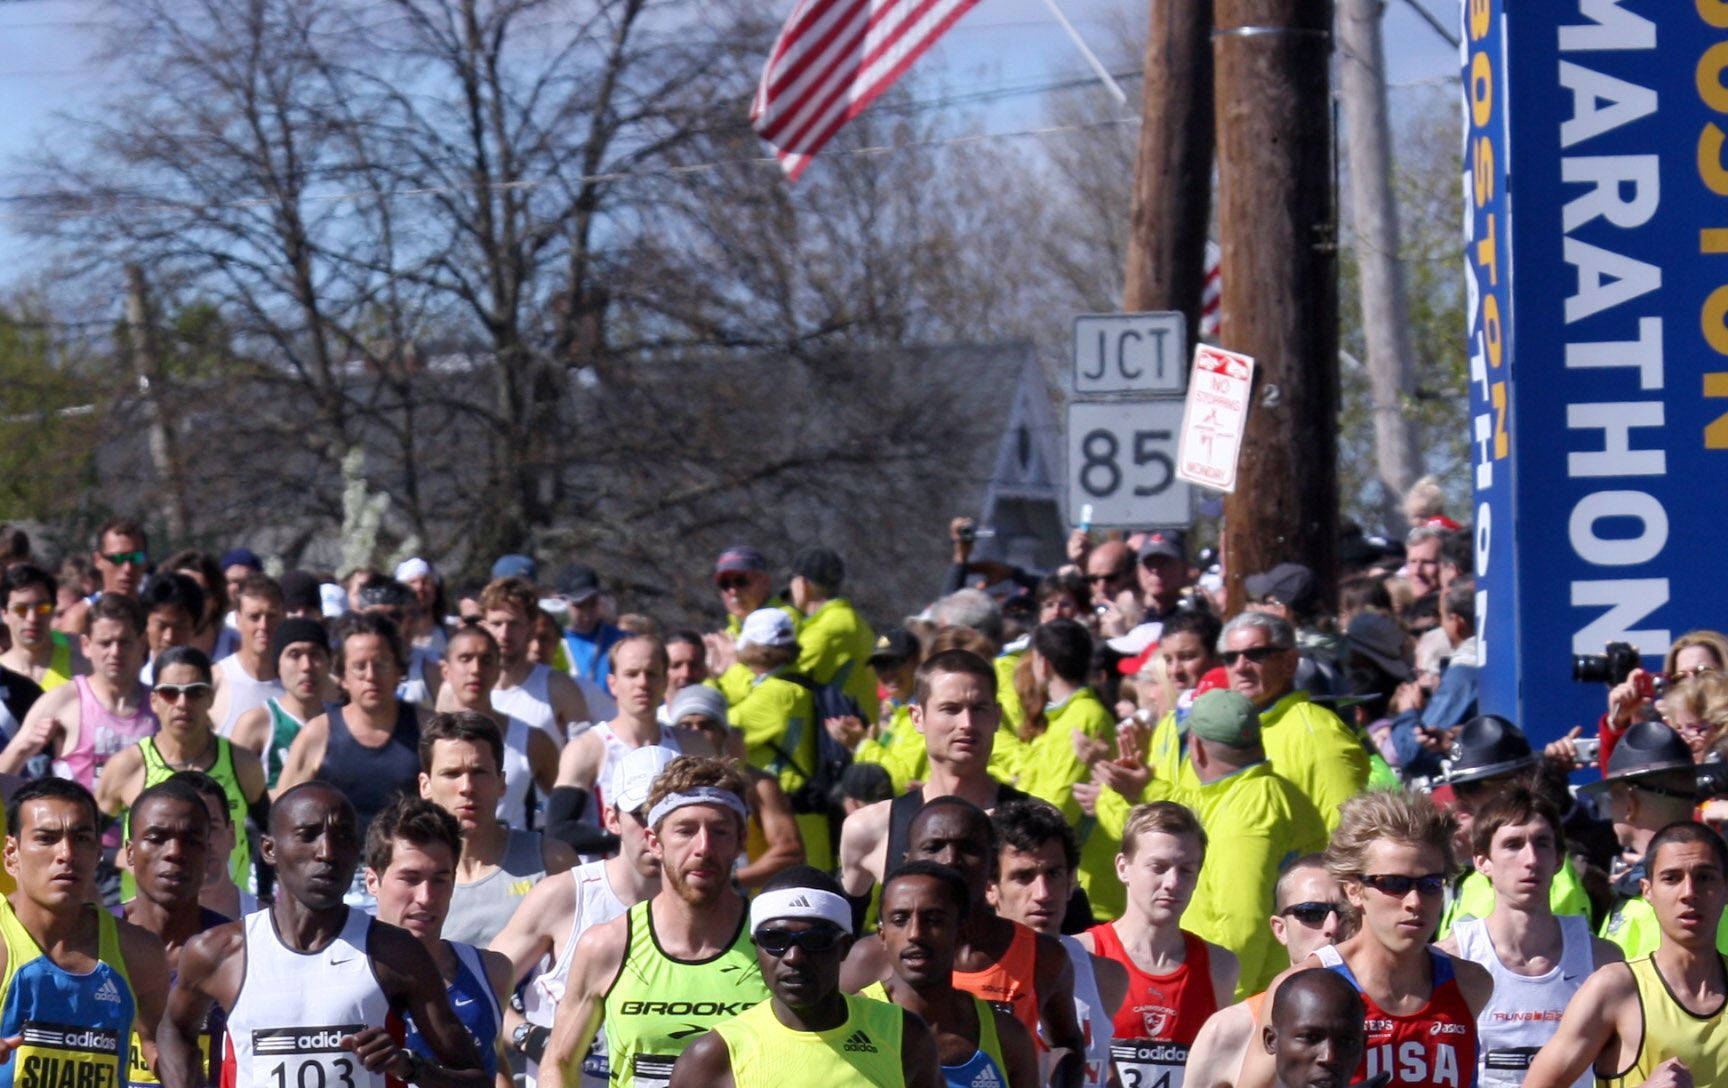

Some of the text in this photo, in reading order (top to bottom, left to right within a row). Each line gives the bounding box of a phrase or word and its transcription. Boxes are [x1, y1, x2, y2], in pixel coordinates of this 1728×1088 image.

[1084, 328, 1171, 380] JCT
[1079, 427, 1176, 498] 85
[94, 991, 121, 1004] adidas
[65, 1031, 117, 1050] adidas
[297, 1031, 342, 1049] adid
[843, 1043, 879, 1054] adidas
[1367, 1041, 1459, 1088] USA
[972, 1079, 1000, 1088] adidas
